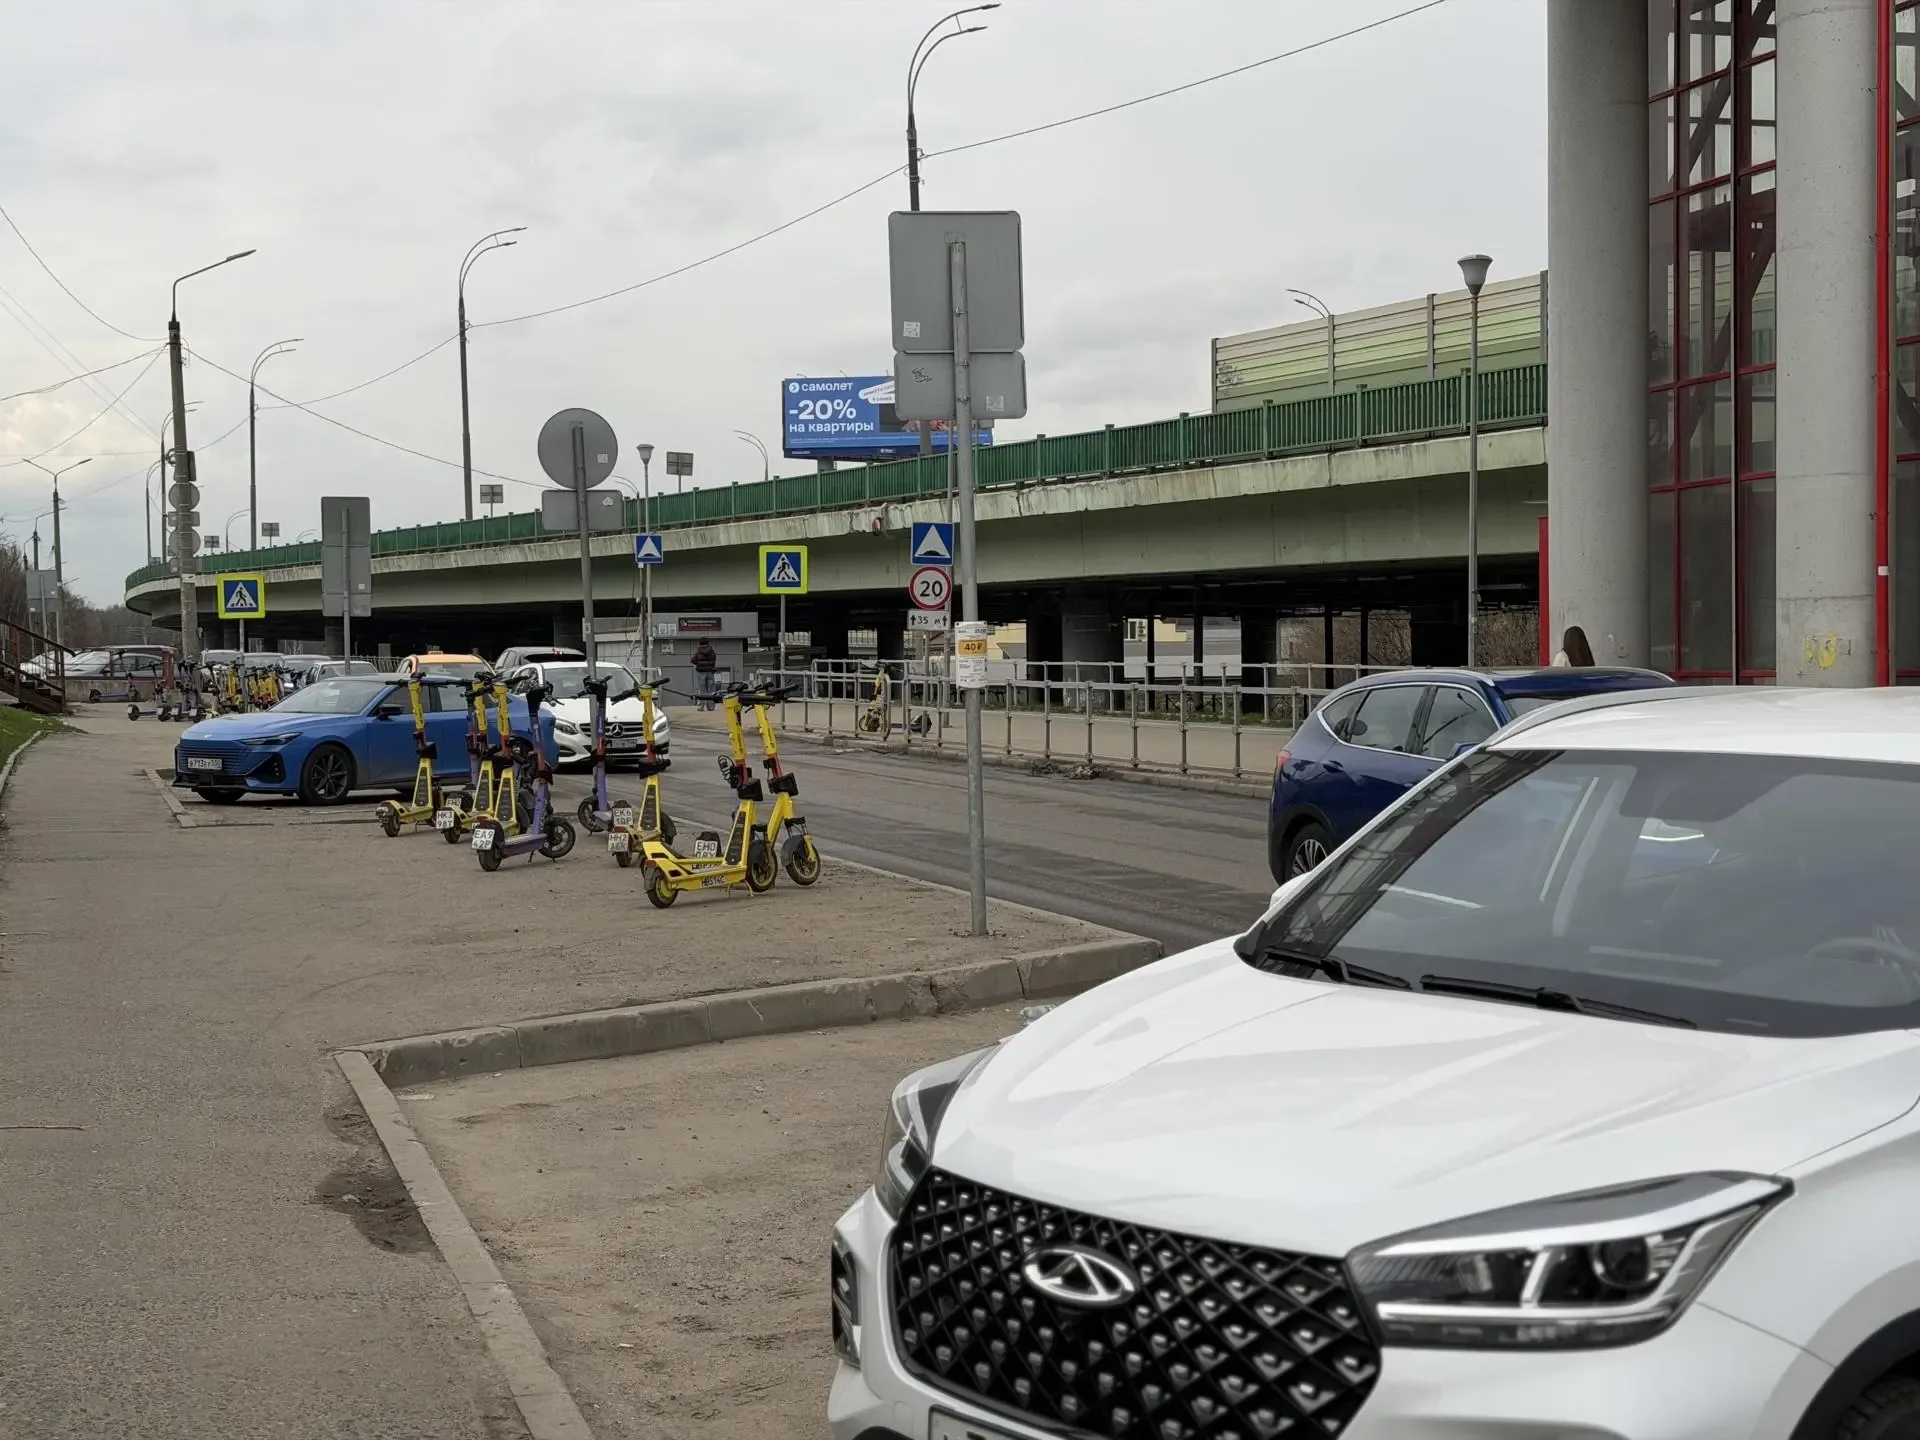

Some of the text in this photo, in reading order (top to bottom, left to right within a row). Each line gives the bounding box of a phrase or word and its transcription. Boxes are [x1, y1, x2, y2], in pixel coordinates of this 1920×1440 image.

[801, 382, 853, 392] самолет
[789, 399, 857, 420] -20%
[789, 422, 874, 434] на квартиры
[920, 580, 943, 597] 20
[917, 615, 929, 625] 35
[474, 830, 494, 839] ЕА9
[473, 840, 492, 849] 42Р
